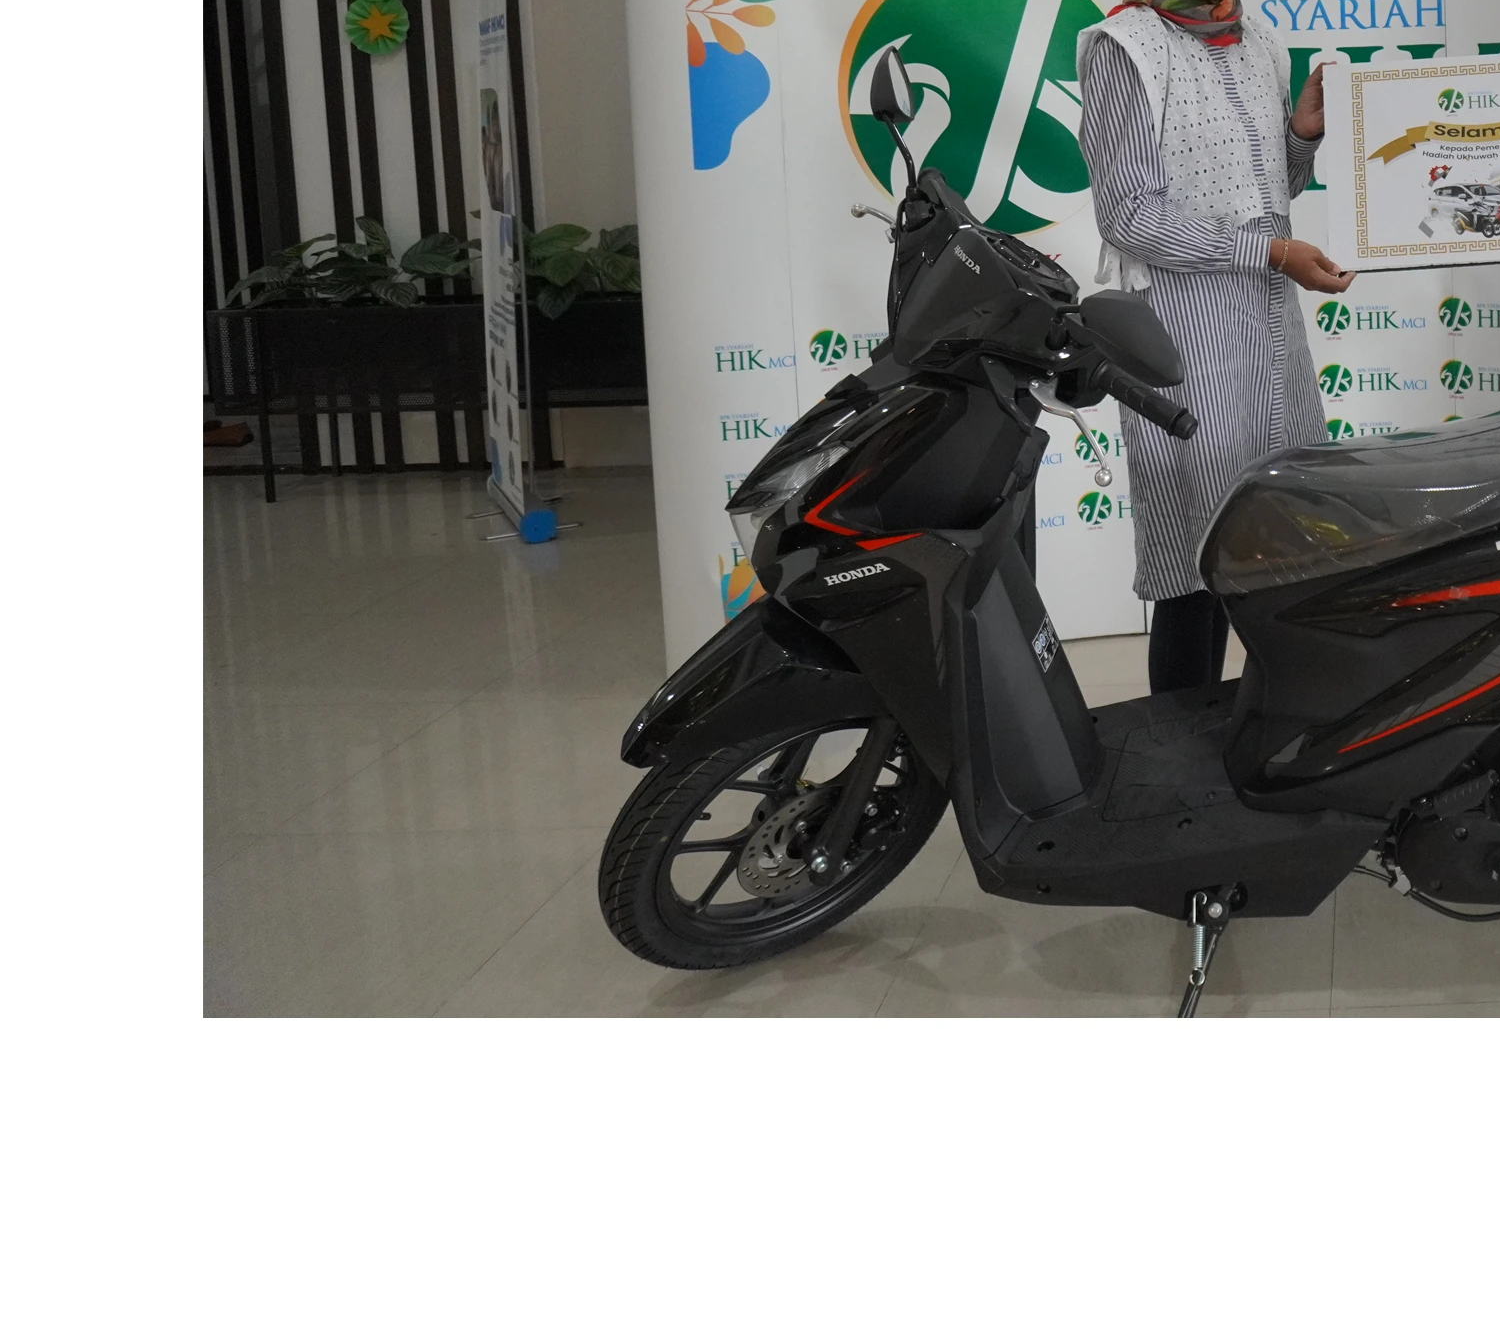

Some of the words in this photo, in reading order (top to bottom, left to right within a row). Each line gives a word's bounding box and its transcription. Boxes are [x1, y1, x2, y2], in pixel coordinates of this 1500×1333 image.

[1468, 94, 1500, 109] HIK
[1423, 151, 1454, 159] Hadiah
[1440, 144, 1473, 153] Kepada
[954, 245, 980, 274] HONDA
[1357, 311, 1399, 330] HIK
[1402, 318, 1425, 328] MCI
[715, 350, 766, 372] HIK
[769, 356, 796, 368] MCI
[824, 563, 890, 586] HONDA
